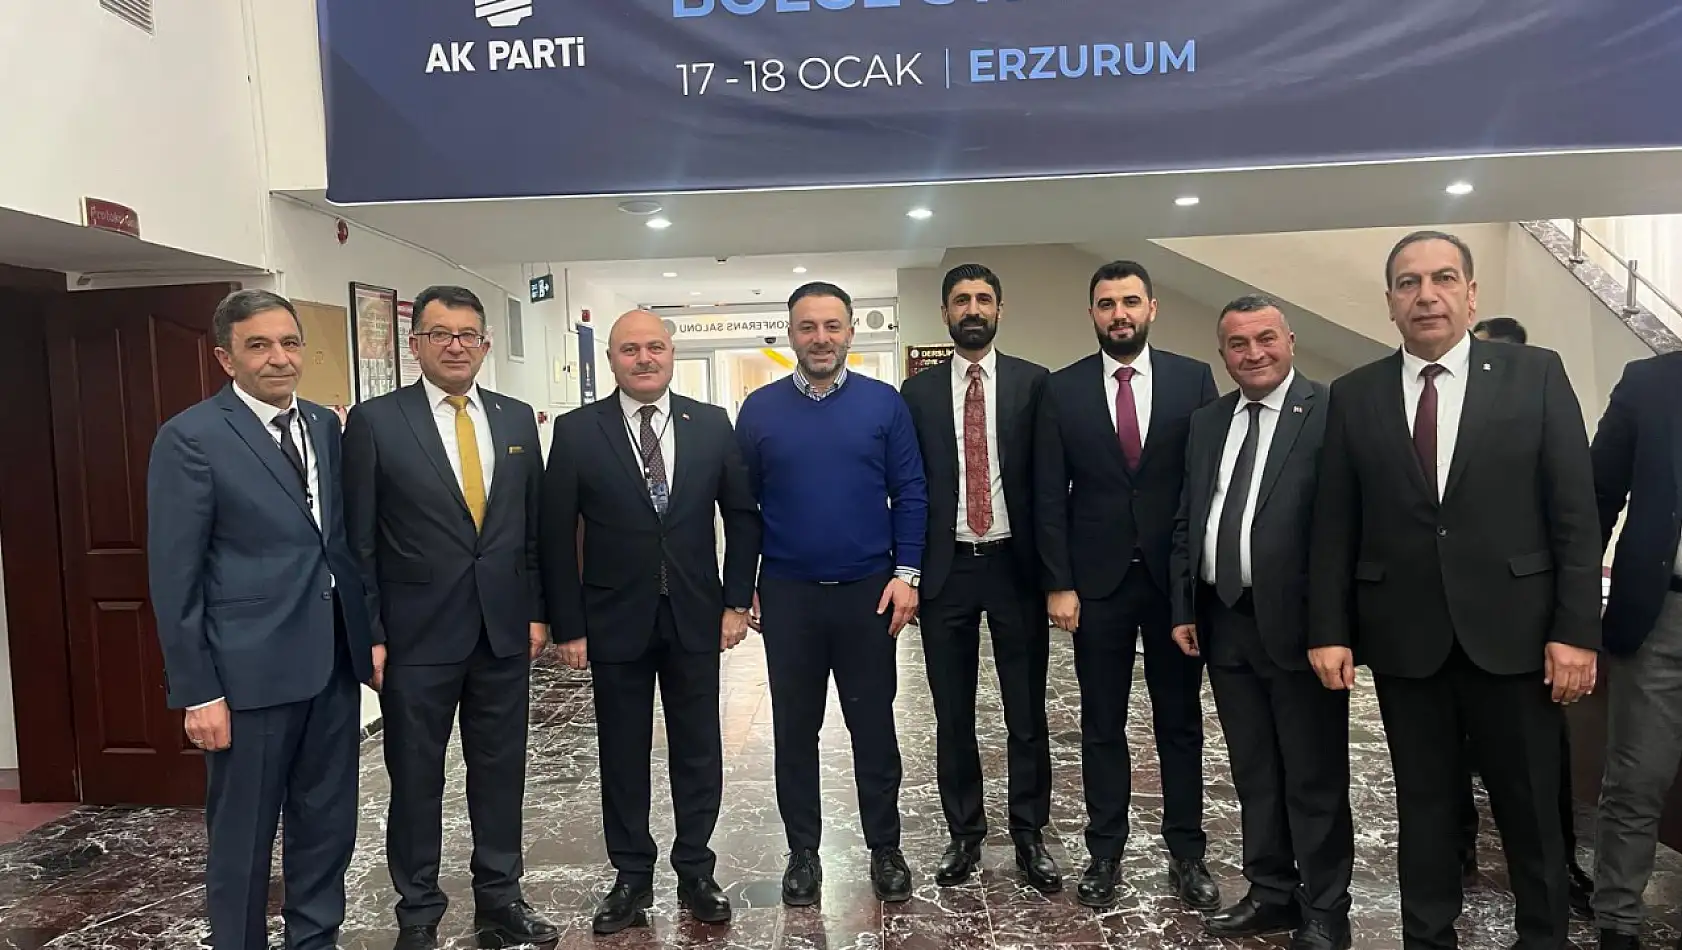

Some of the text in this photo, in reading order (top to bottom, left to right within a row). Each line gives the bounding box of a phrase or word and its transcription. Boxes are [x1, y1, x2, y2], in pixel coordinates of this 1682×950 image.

[425, 42, 476, 74] AK
[676, 62, 716, 96] 17
[798, 52, 924, 90] OCAK
[970, 39, 1196, 83] ERZURUM
